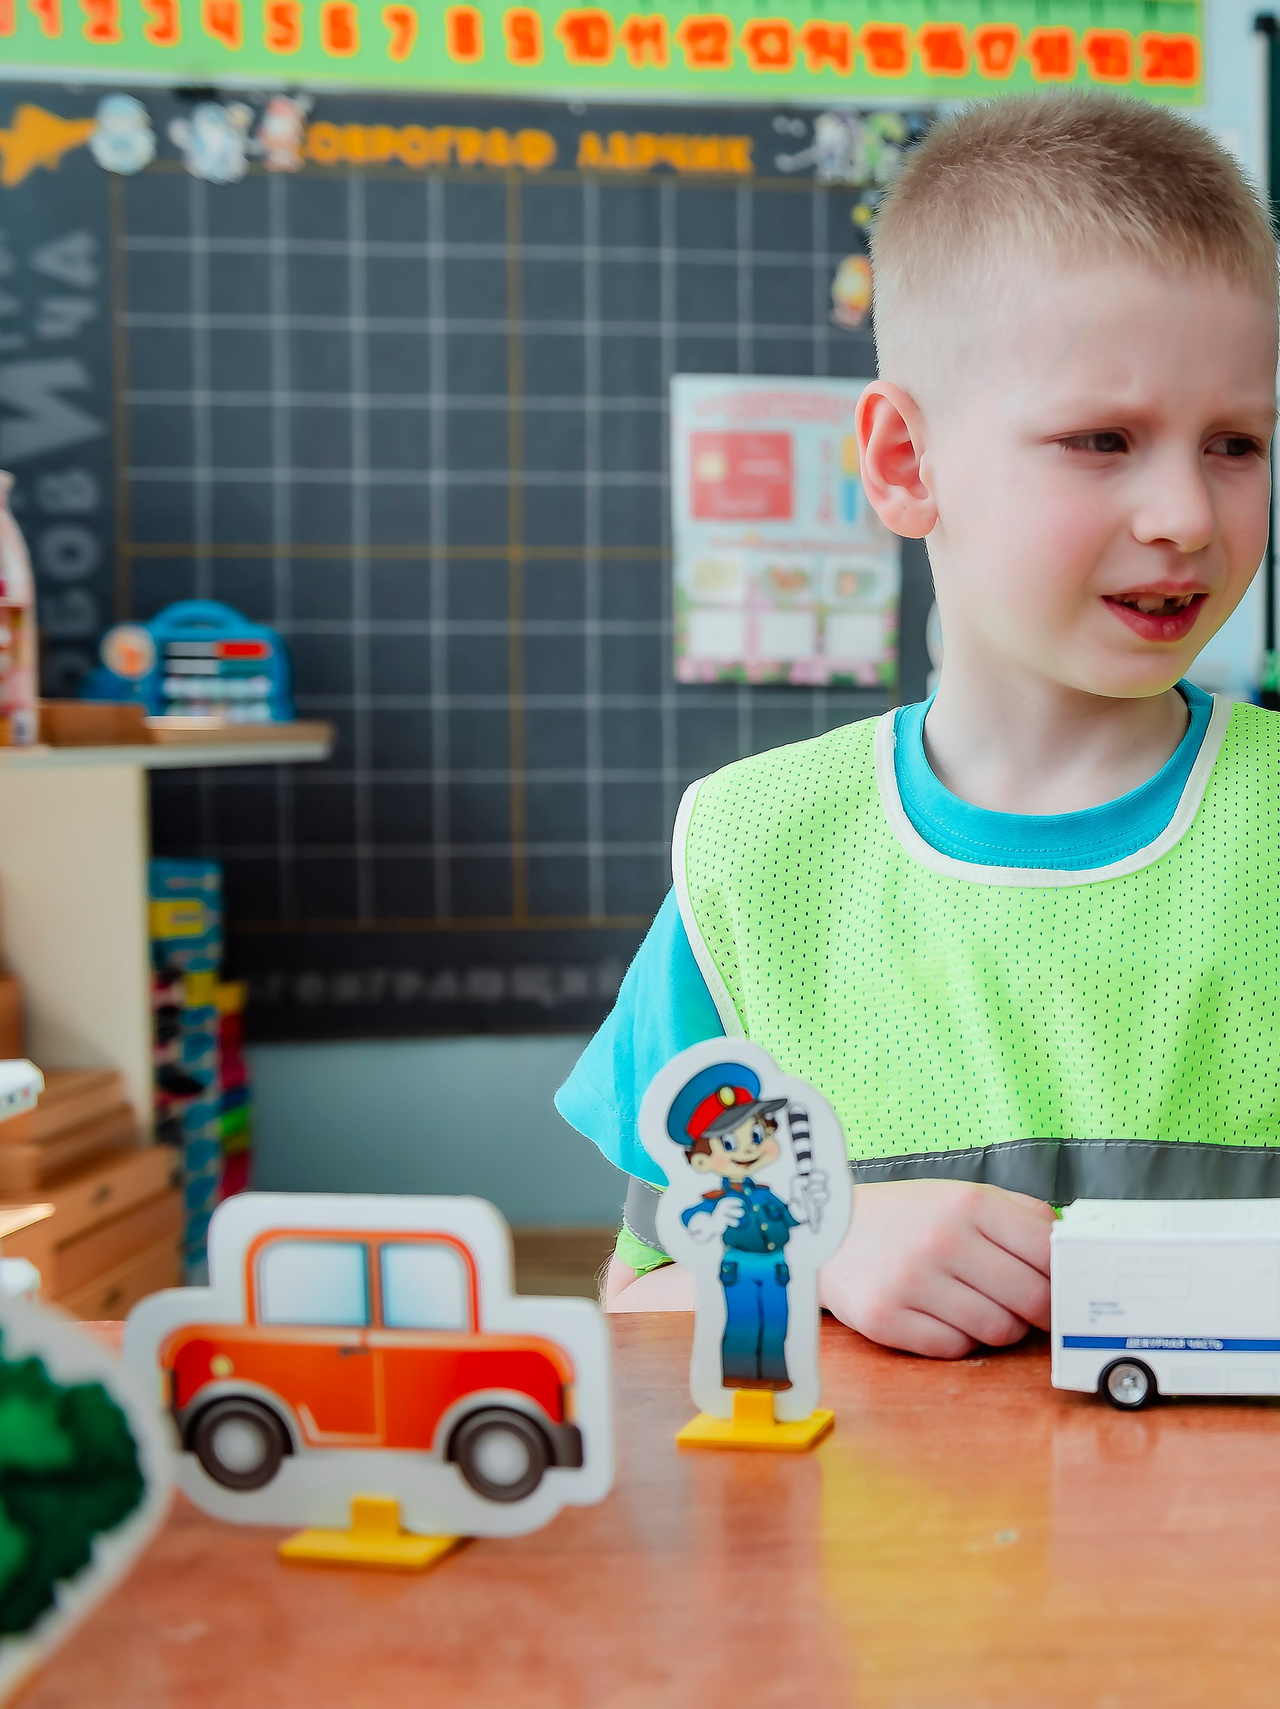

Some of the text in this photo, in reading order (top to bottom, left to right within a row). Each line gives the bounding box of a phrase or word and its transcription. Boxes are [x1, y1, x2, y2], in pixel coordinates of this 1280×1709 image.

[82, 0, 119, 42] 2
[144, 0, 178, 45] 3
[204, 0, 240, 48] 4
[266, 2, 299, 52] 5
[323, 2, 356, 55] 6
[385, 8, 415, 58] 7
[448, 8, 481, 61] 8
[506, 10, 541, 64] 9
[558, 10, 613, 64] 10
[619, 16, 667, 65] 11
[677, 16, 732, 68] 12
[741, 19, 795, 72] 13
[799, 22, 852, 74] 14
[859, 23, 909, 75] 15
[972, 25, 1020, 77] 17
[1138, 33, 1200, 84] 20
